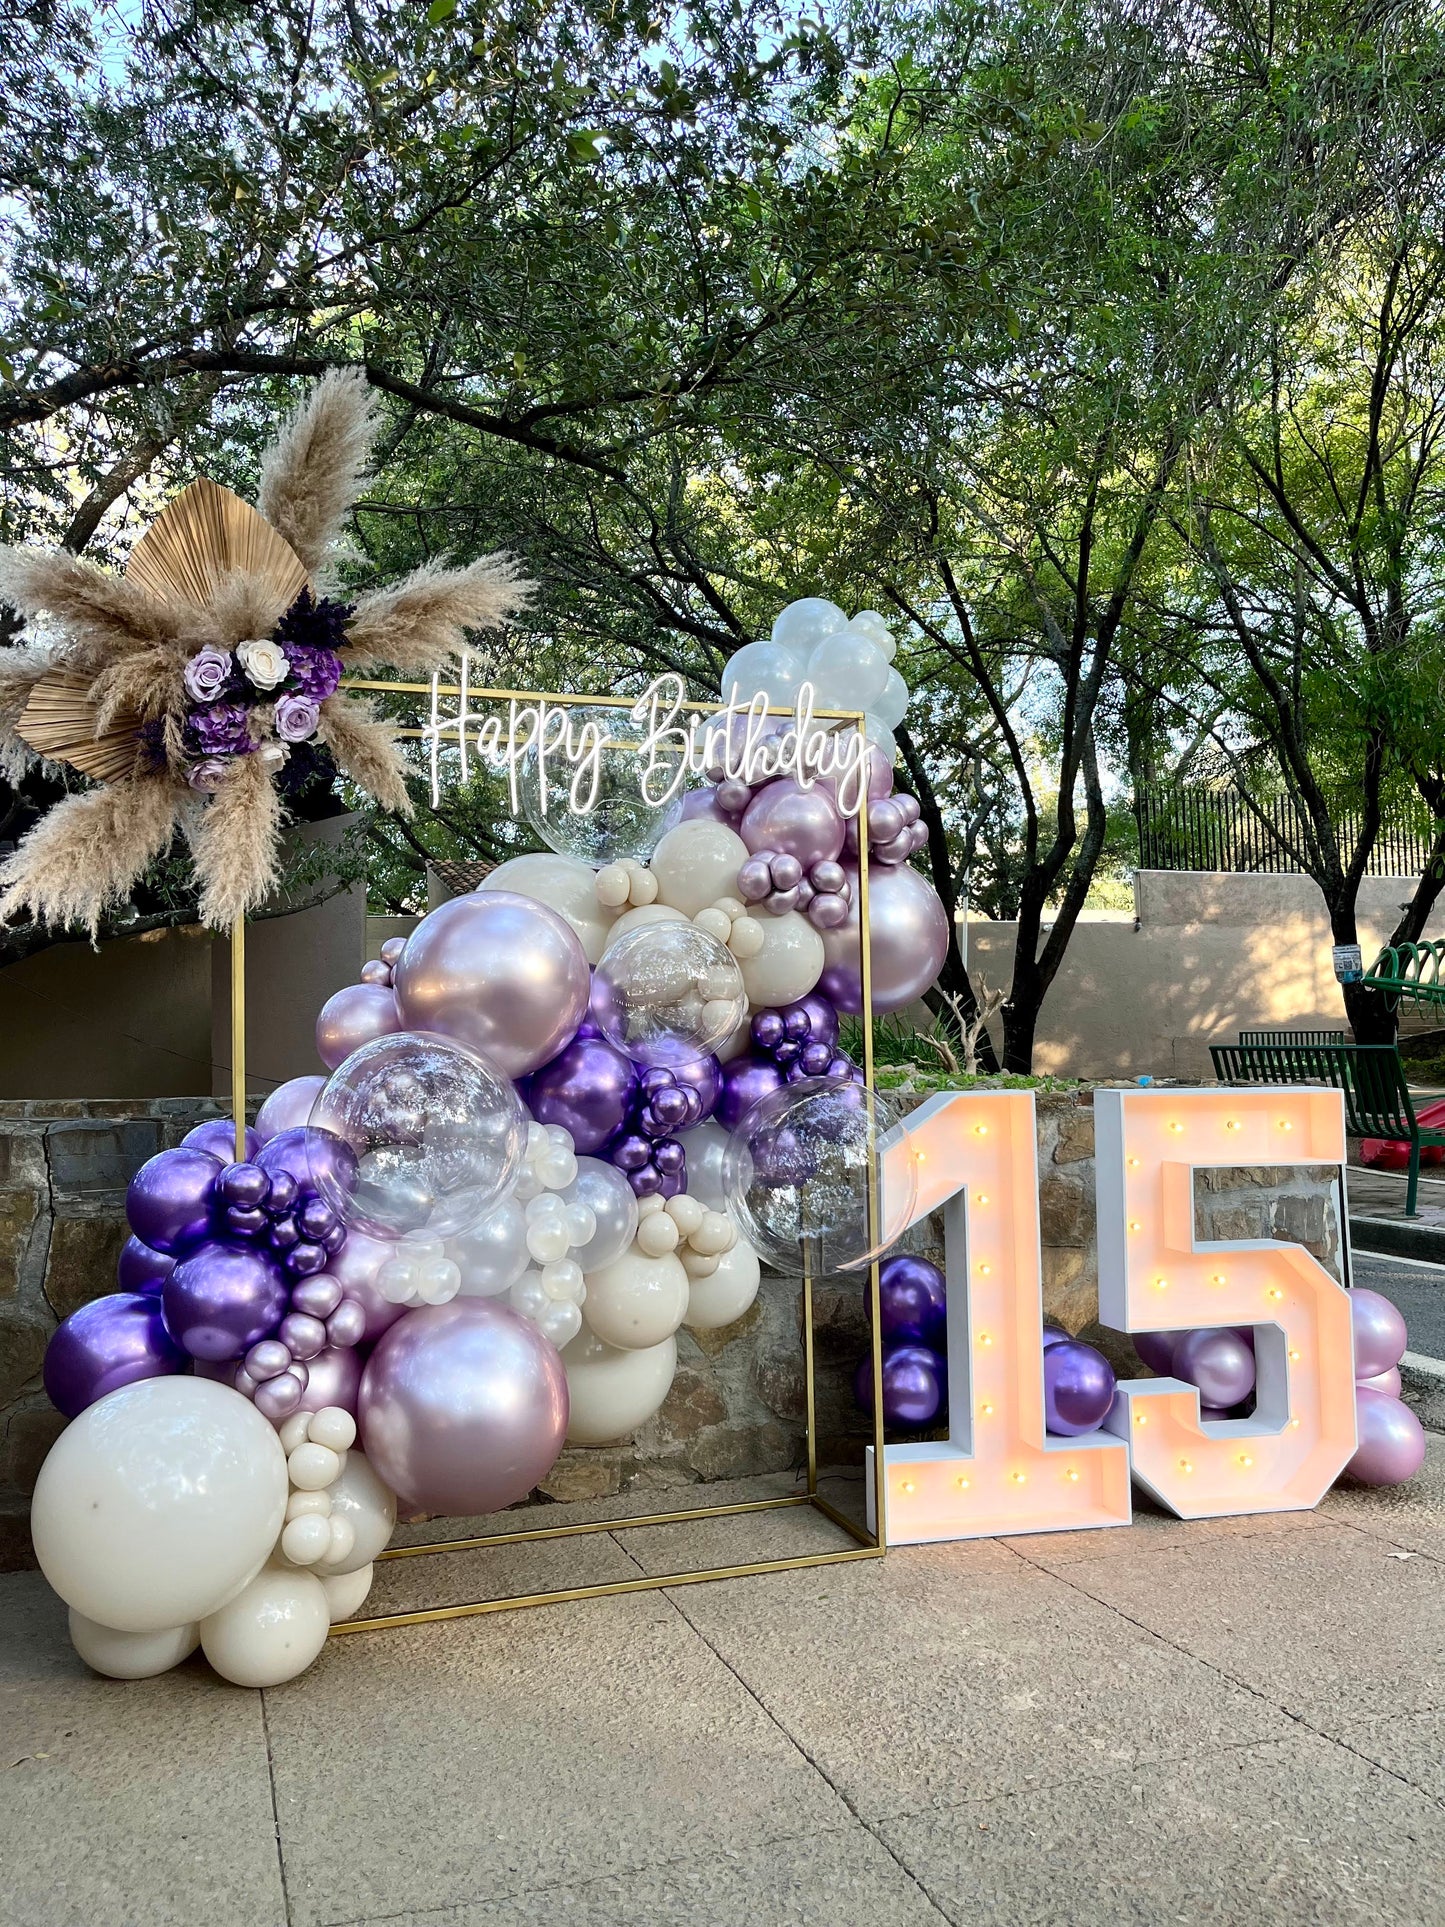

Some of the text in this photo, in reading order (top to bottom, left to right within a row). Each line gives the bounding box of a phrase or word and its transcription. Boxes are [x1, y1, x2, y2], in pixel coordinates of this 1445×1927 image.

[422, 652, 875, 818] Happy Birthday
[866, 1087, 1358, 1545] 15
